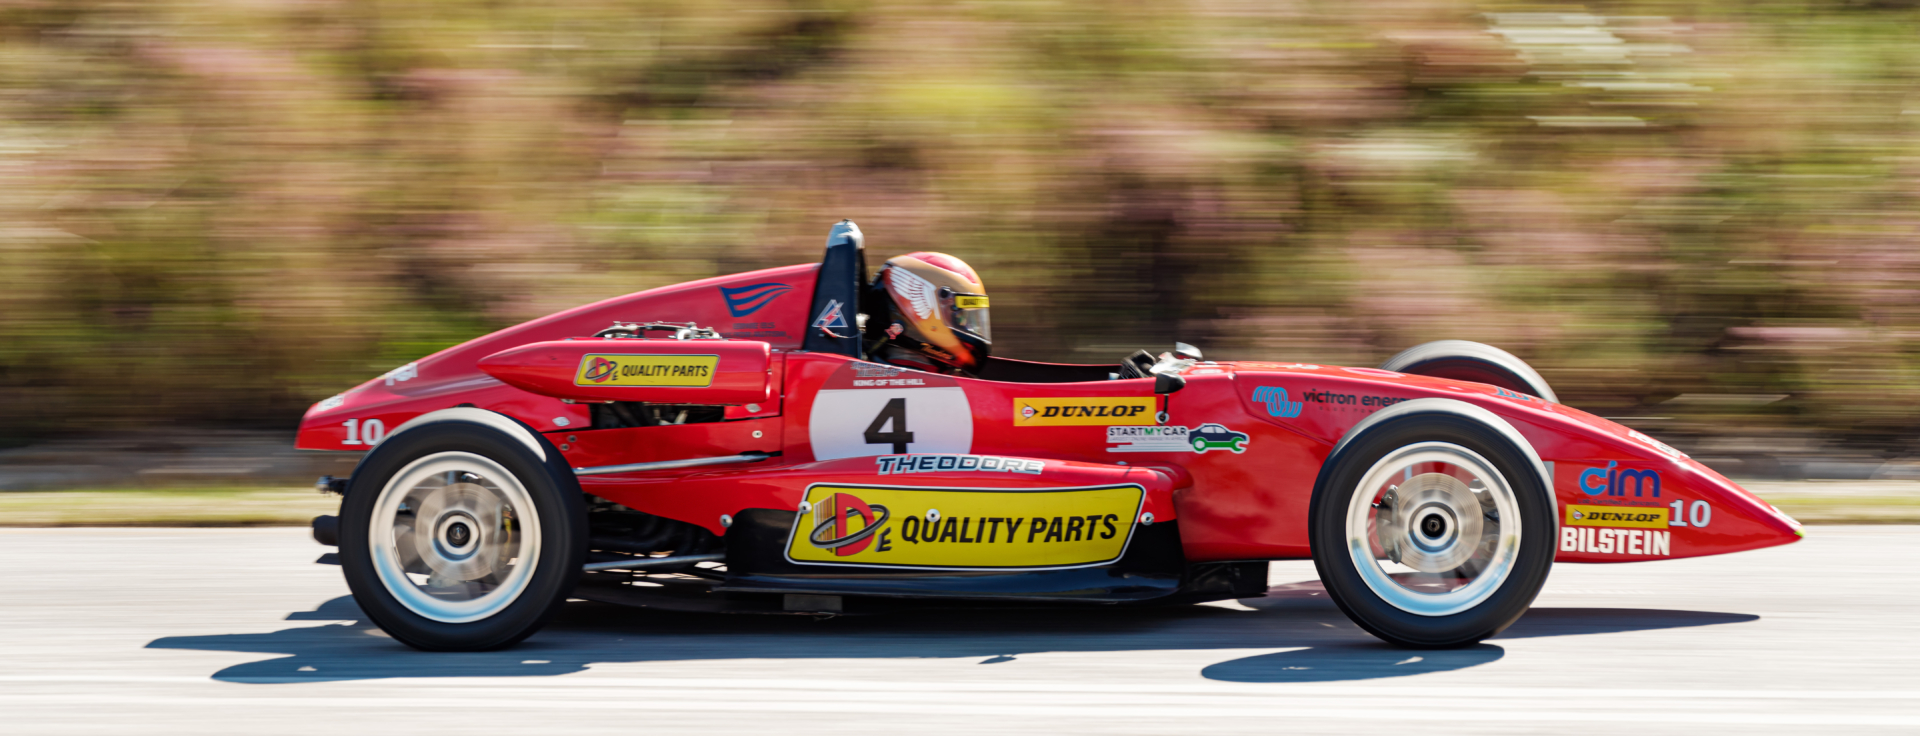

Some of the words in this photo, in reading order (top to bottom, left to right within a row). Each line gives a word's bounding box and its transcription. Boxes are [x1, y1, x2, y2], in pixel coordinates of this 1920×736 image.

[621, 364, 671, 377] QUALITY
[671, 365, 709, 377] PARTS
[1302, 388, 1357, 406] victron
[1041, 405, 1146, 418] DUNLOP
[341, 418, 385, 446] 10
[863, 397, 915, 455] 4
[1109, 427, 1187, 436] STARTMYCAR
[877, 455, 1044, 474] THEODORE
[1586, 511, 1661, 522] DUNLOP
[1668, 499, 1711, 528] 10
[901, 515, 1024, 545] QUALITY
[1027, 514, 1119, 544] PARTS
[1560, 526, 1671, 556] BILSTEIN
